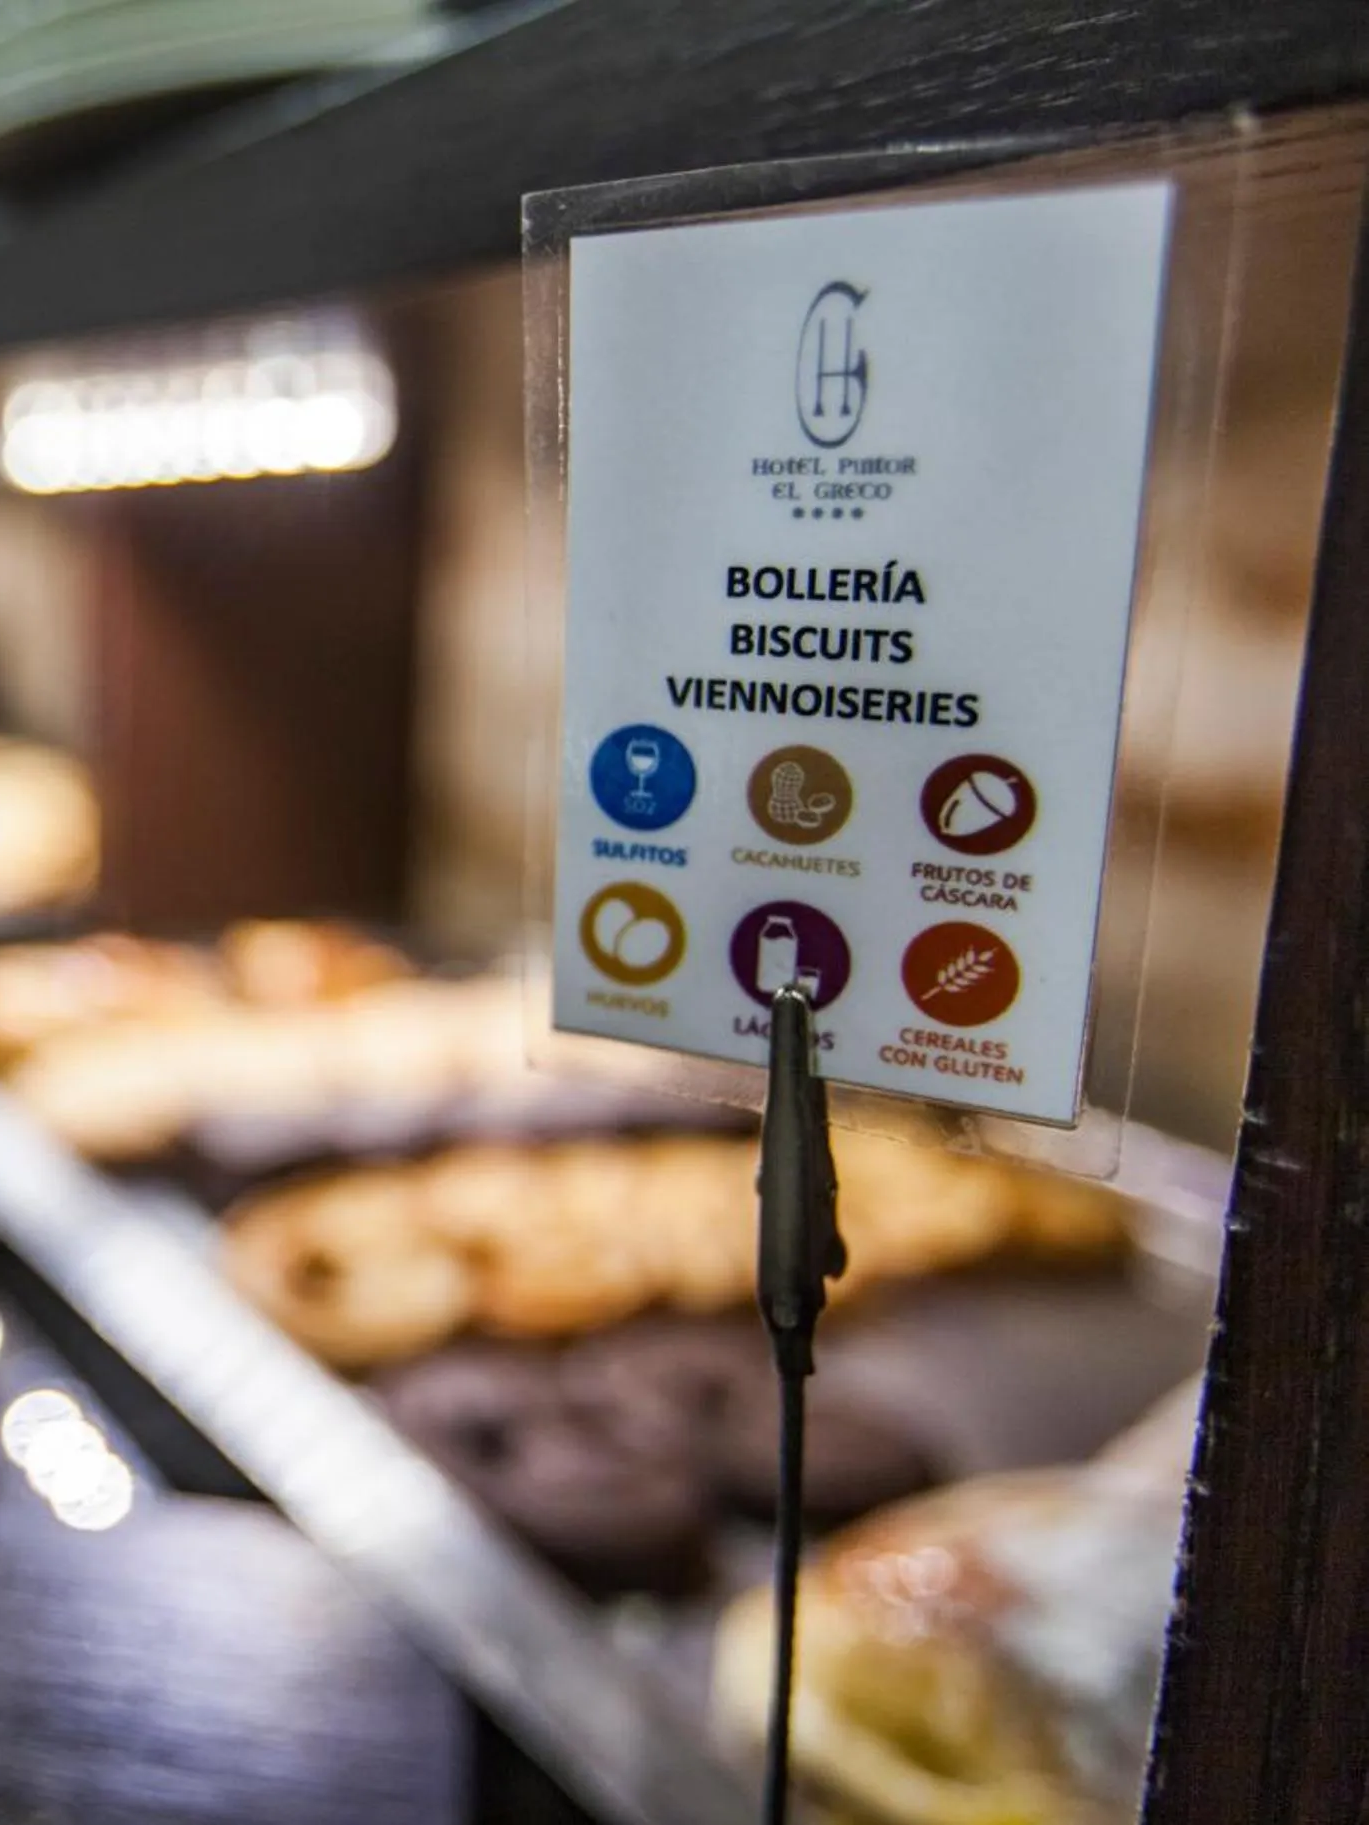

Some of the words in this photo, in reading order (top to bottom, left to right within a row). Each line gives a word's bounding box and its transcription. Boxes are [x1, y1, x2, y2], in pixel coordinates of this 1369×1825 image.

[771, 481, 802, 500] EL
[813, 481, 893, 501] GRECO
[726, 560, 925, 604] BOLLERÍA
[730, 624, 914, 663] BISCUITS
[666, 676, 979, 728] VIENNOISERIES
[592, 838, 687, 867] SULFITOS
[732, 847, 861, 877] CACAHUETES
[911, 862, 995, 887] FRUTOS
[1002, 872, 1033, 892] DE
[921, 883, 1018, 911] CÁSCARA
[900, 1027, 1008, 1060] CEREALES
[879, 1045, 927, 1068] CON
[933, 1055, 1025, 1085] GLUTEN
